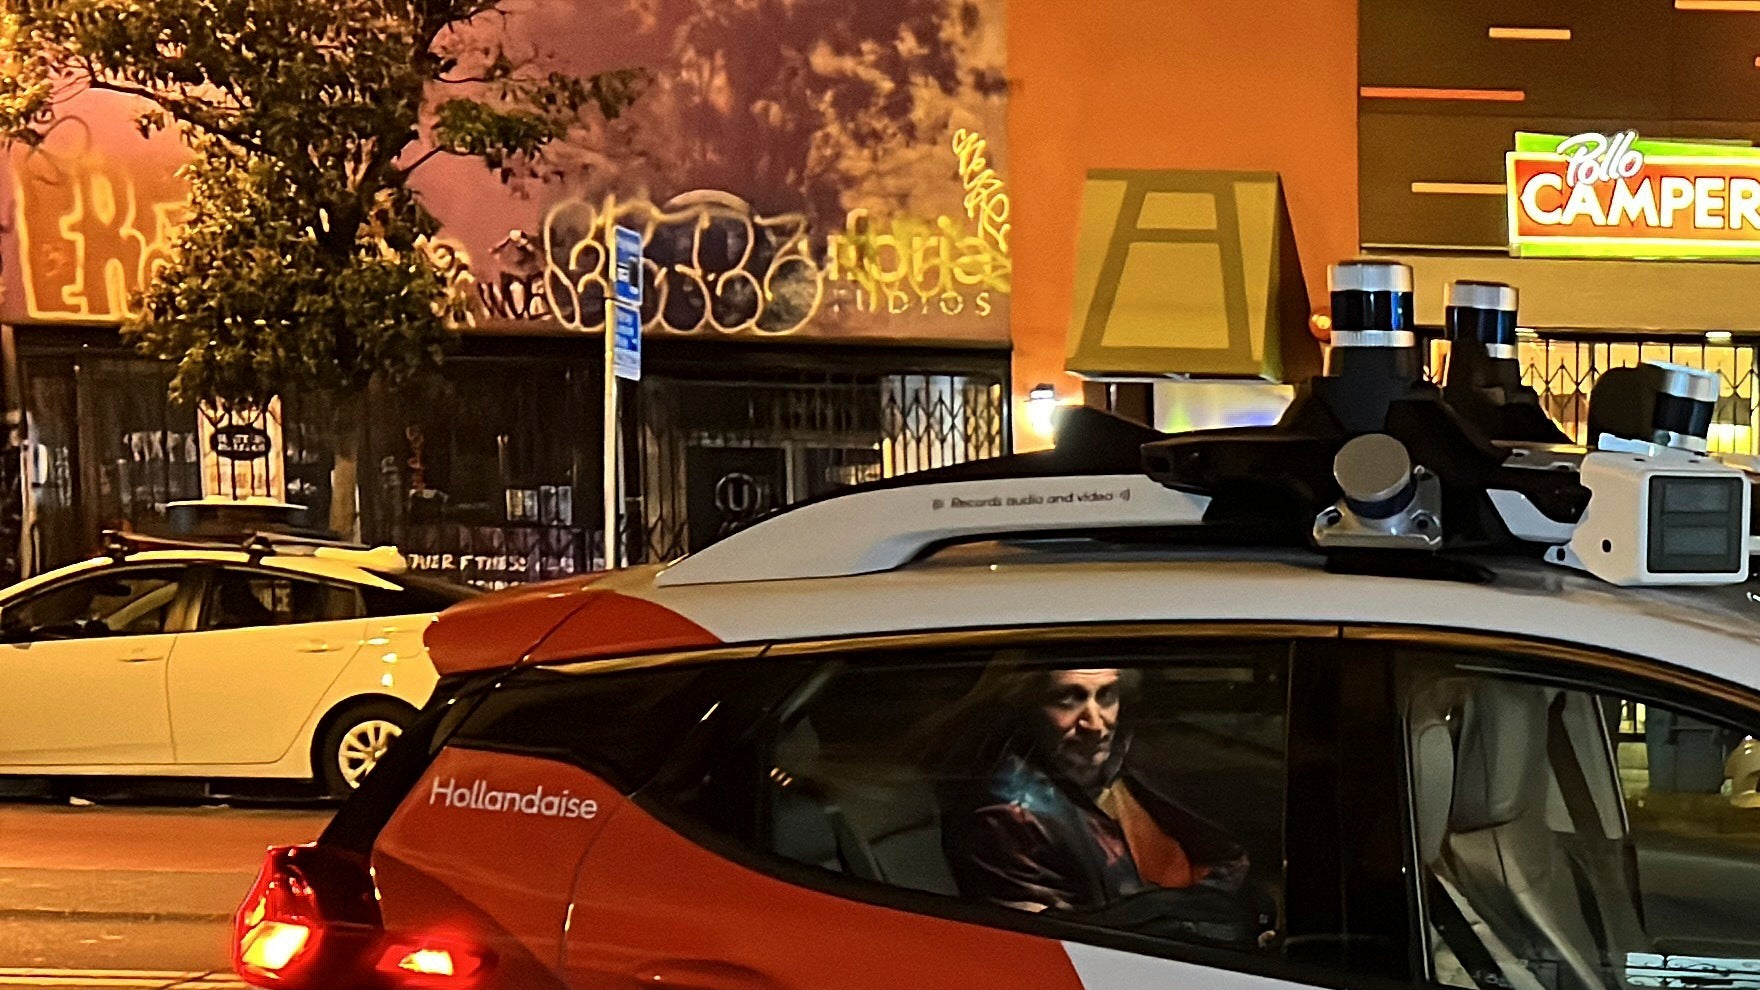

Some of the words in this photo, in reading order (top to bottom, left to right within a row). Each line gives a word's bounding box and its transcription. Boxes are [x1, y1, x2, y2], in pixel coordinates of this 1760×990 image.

[1556, 128, 1644, 187] Pollo
[951, 496, 1002, 508] Records
[1006, 494, 1044, 506] audio
[1047, 492, 1074, 504] and
[1076, 491, 1114, 503] video
[429, 776, 598, 820] Hollandaise
